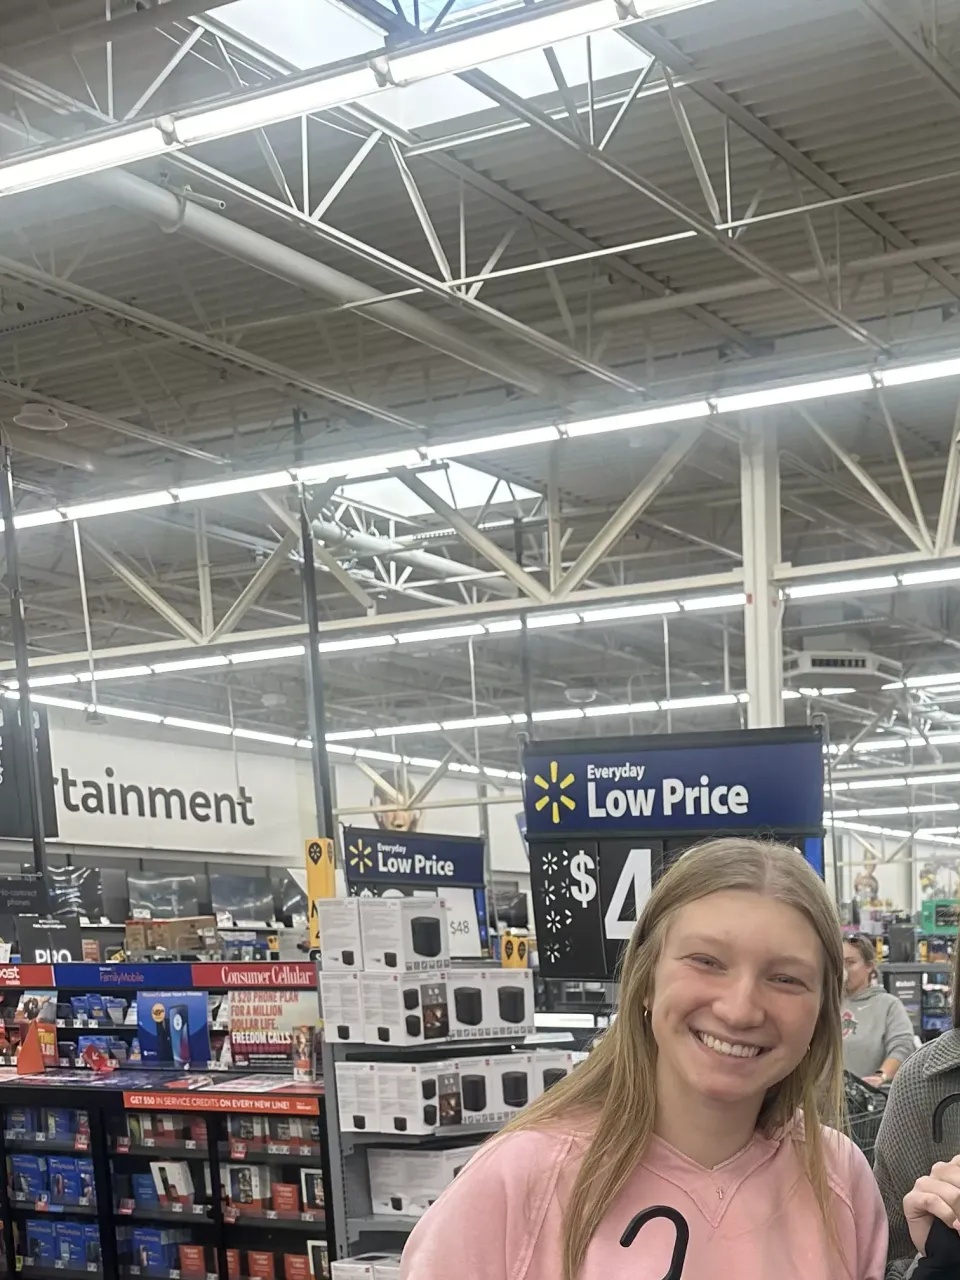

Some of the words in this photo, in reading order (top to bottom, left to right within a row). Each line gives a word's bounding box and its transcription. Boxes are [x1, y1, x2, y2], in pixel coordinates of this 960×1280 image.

[587, 762, 645, 782] Everyday
[54, 766, 255, 826] tainment
[587, 781, 656, 817] Low
[662, 775, 749, 816] Price
[377, 843, 406, 854] Everyday
[377, 852, 412, 874] Low
[414, 855, 454, 876] Price
[450, 921, 470, 934] $48
[221, 966, 271, 985] Consumer
[272, 966, 313, 985] Cellular
[280, 992, 298, 1003] PLAN
[231, 1005, 245, 1016] FOR
[246, 1005, 252, 1016] A
[253, 1005, 282, 1016] MILLION
[231, 1018, 259, 1030] DOLLAR
[232, 1032, 267, 1044] FREEDOM
[130, 1095, 143, 1104] GET
[144, 1096, 155, 1105] $50
[156, 1097, 163, 1105] IN
[163, 1097, 191, 1106] SERVICE
[191, 1098, 219, 1108] CREDITS
[220, 1099, 231, 1108] ON
[231, 1100, 254, 1109] EVERY
[254, 1101, 271, 1109] NEW
[272, 1101, 290, 1110] LINE!
